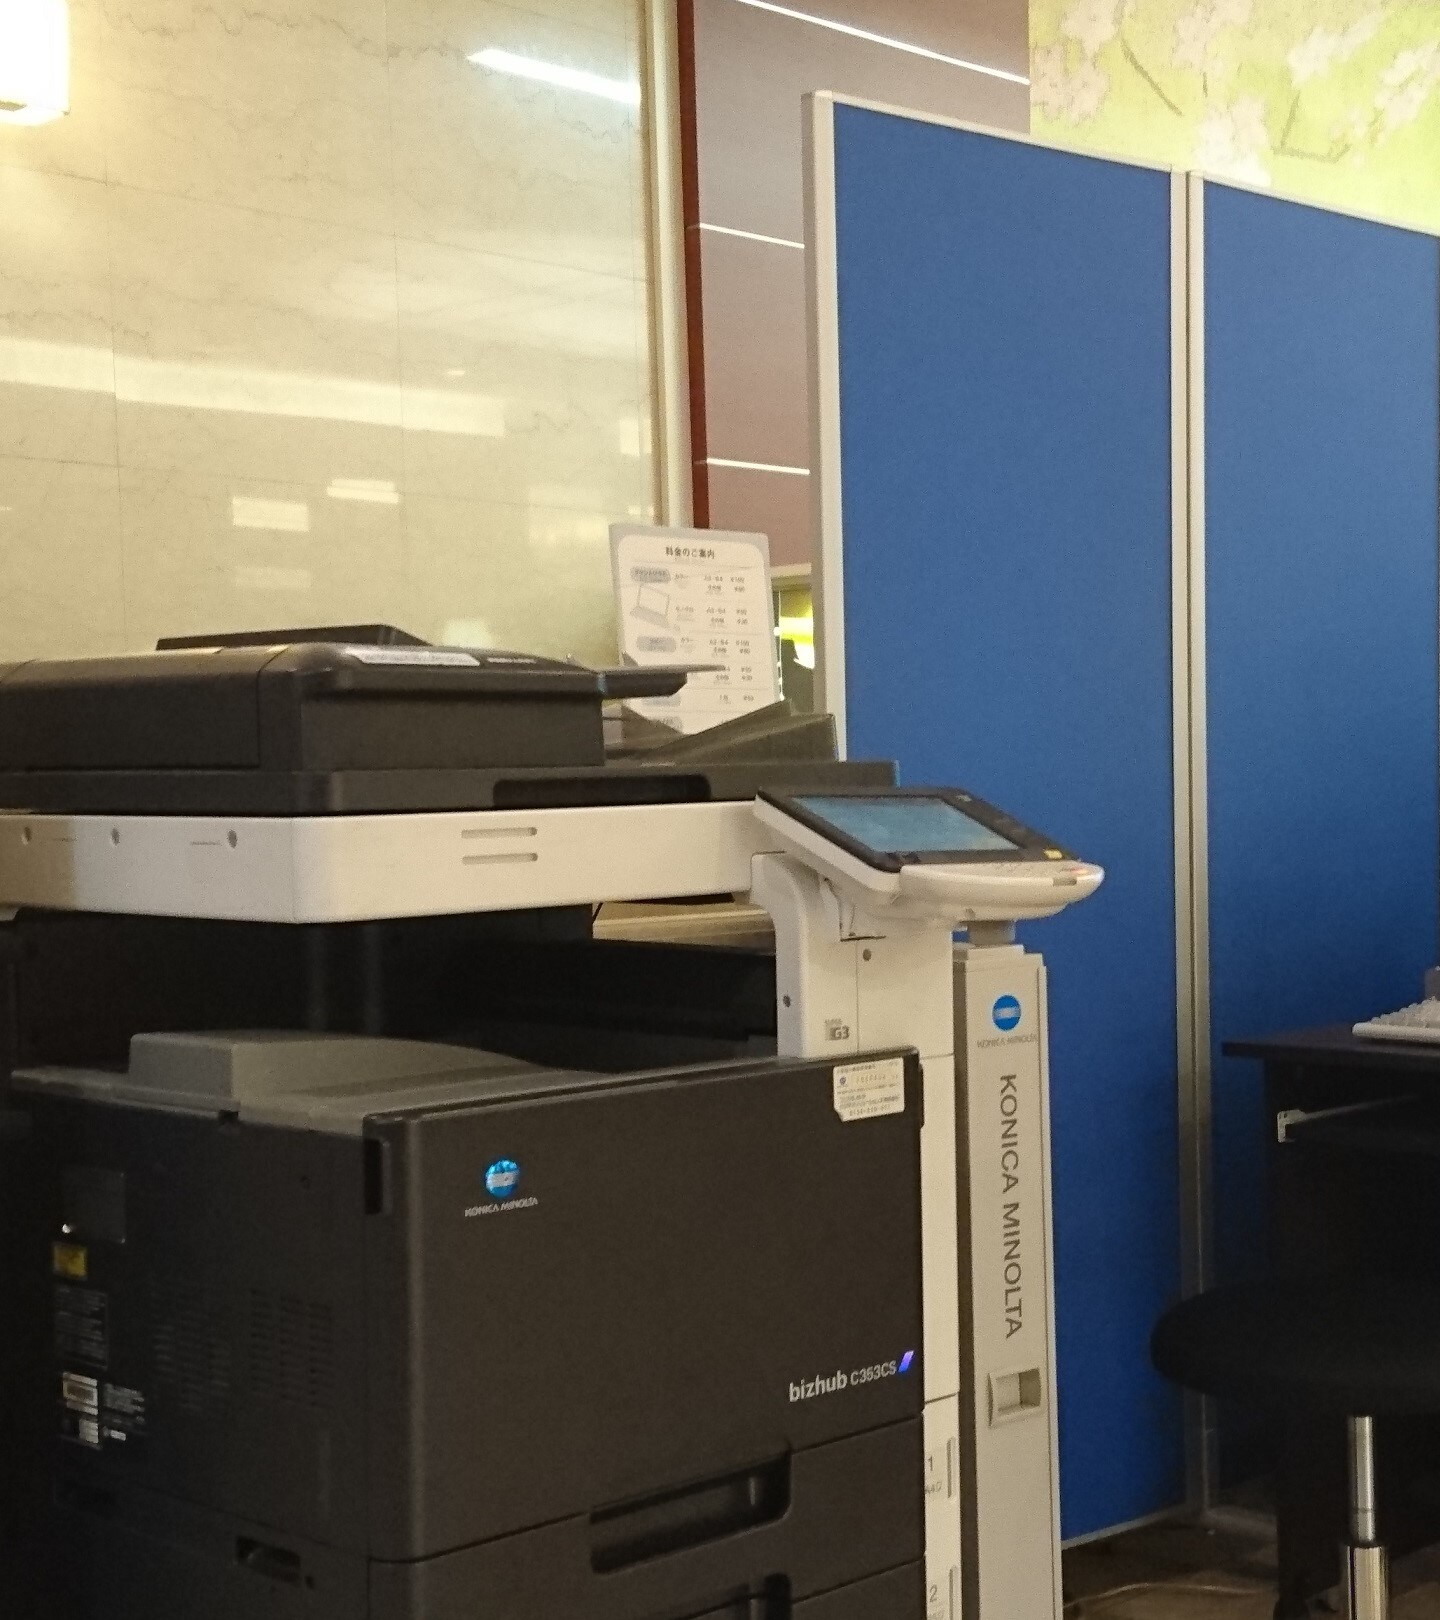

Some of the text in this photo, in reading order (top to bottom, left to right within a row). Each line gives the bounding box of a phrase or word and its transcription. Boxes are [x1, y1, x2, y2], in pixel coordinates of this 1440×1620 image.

[464, 1196, 539, 1217] KONICA MINOLTA
[1000, 1074, 1023, 1339] KONICA MINOLTA
[788, 1370, 848, 1403] bizhub
[929, 1584, 938, 1603] 2
